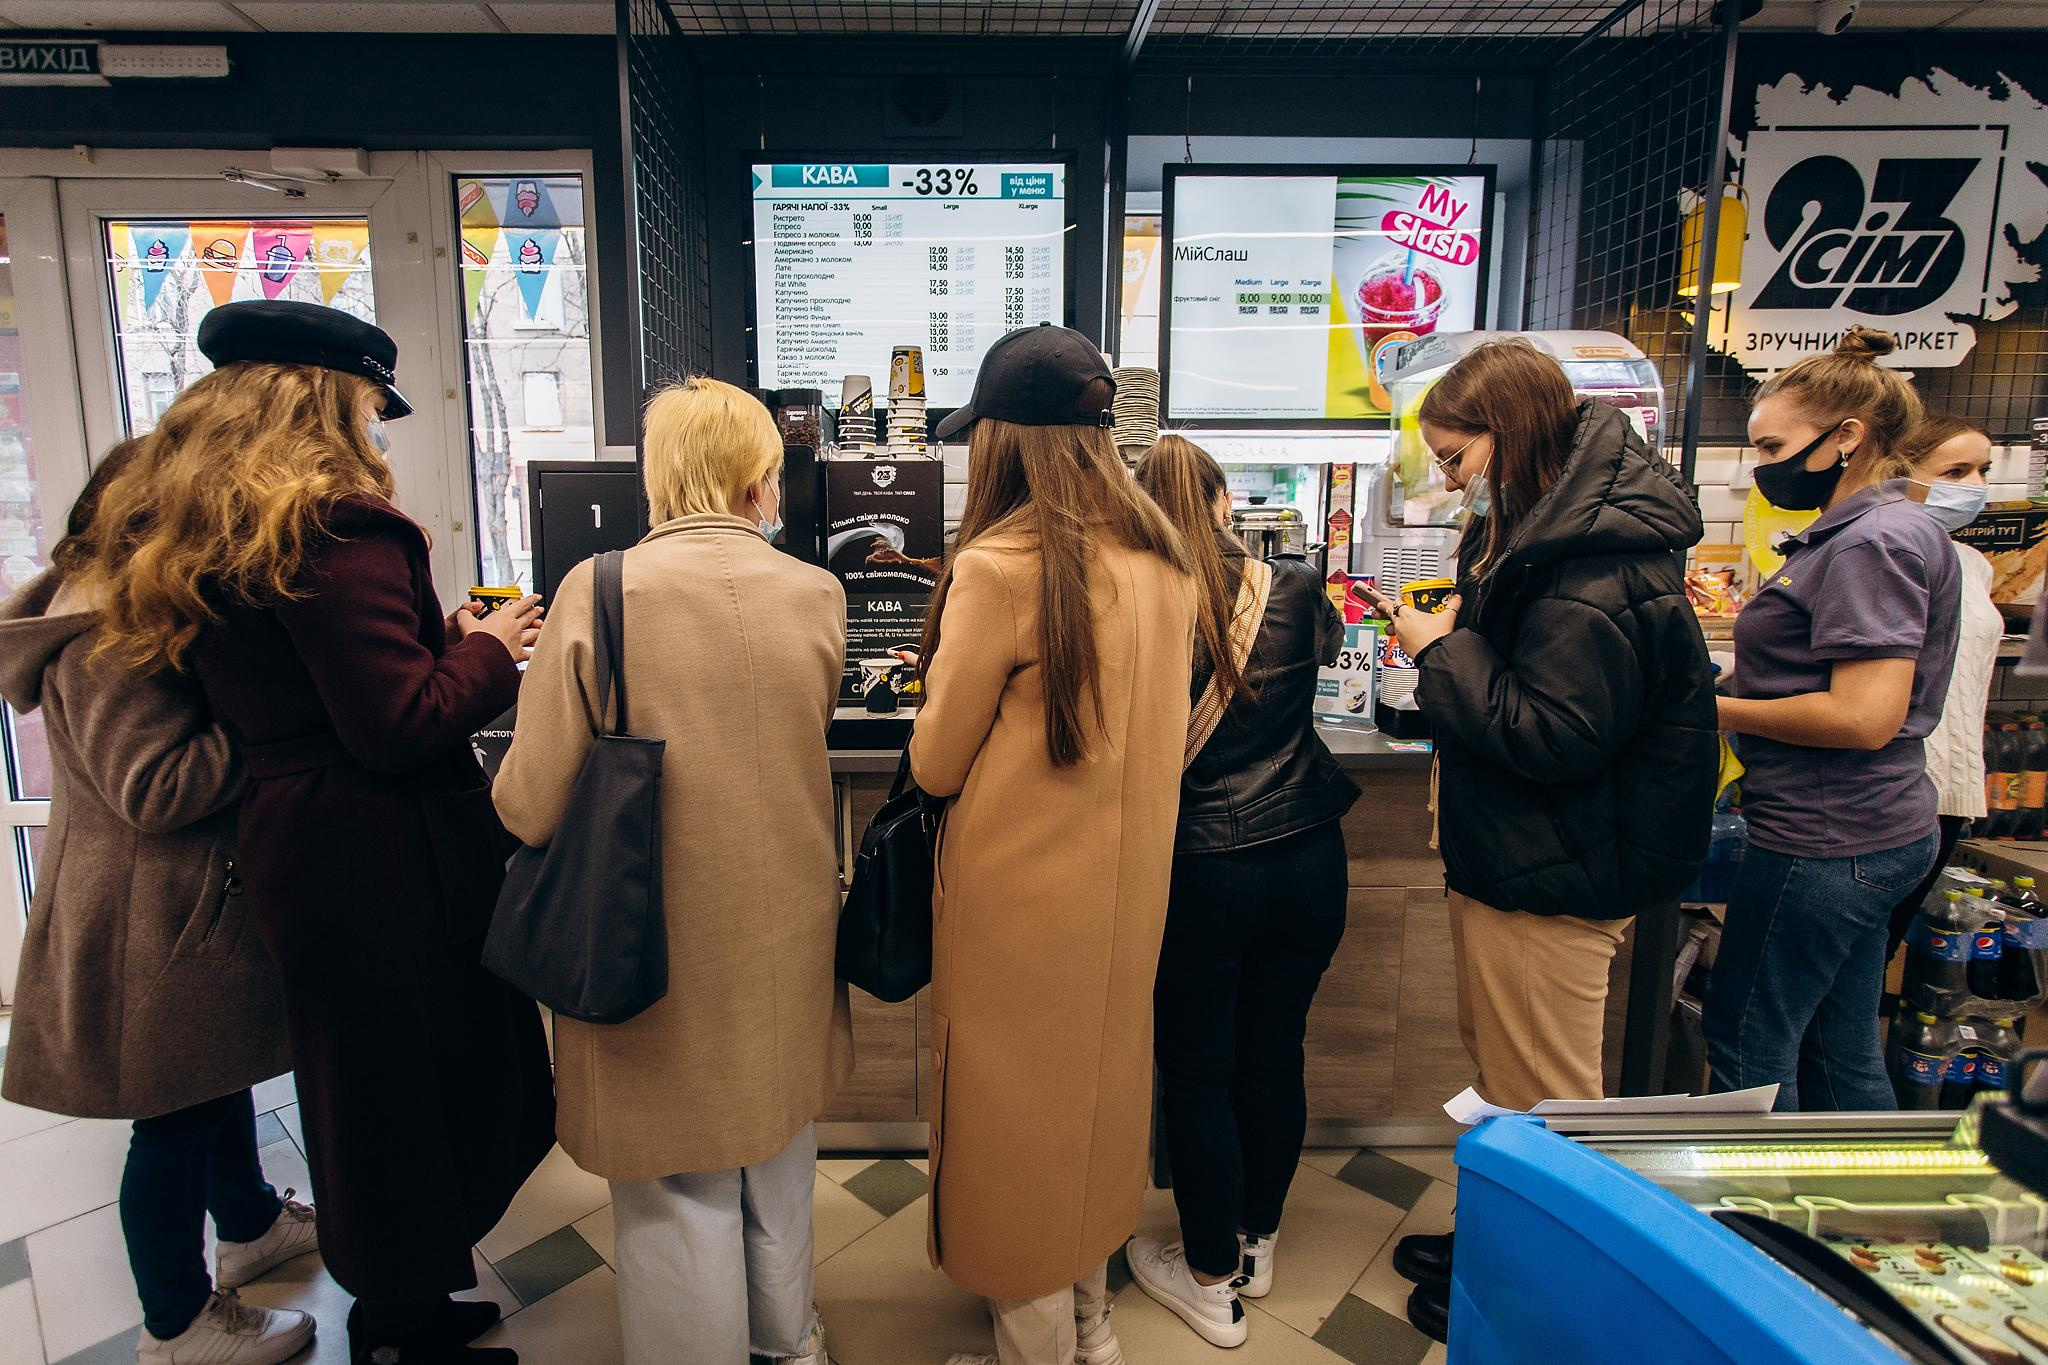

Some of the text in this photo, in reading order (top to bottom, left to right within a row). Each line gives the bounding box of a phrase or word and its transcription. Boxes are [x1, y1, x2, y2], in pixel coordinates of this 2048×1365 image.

[0, 48, 90, 71] ВИХІД
[802, 166, 978, 196] КАВА -33%
[1009, 176, 1046, 186] від ціни
[1011, 188, 1046, 197] у меню
[772, 202, 850, 211] ГАРЯЧІ НАПОЇ -33%
[1417, 184, 1468, 228] My
[773, 214, 805, 222] Ристрето
[853, 214, 872, 222] 10,00
[773, 223, 801, 231] Еспресо
[853, 222, 872, 230] 10,00
[773, 231, 802, 239] Еспресо
[855, 230, 872, 238] 11,50
[1393, 213, 1471, 263] Slush
[774, 248, 814, 256] Американо
[929, 246, 948, 255] 12,00
[1005, 246, 1024, 255] 14,50
[1174, 246, 1249, 262] МійСлаш
[774, 256, 814, 264] Американо
[929, 255, 948, 263] 13,00
[1005, 255, 1024, 263] 16,00
[929, 263, 948, 271] 14,50
[1005, 263, 1024, 271] 17,50
[774, 272, 792, 280] Лате
[1005, 271, 1024, 279] 17,50
[929, 279, 948, 288] 17,50
[1270, 279, 1289, 287] Large
[775, 289, 808, 297] Капучино
[929, 287, 948, 296] 14,50
[1005, 287, 1024, 296] 17,50
[775, 297, 808, 305] Капучино
[809, 297, 851, 305] прохолодне
[1005, 296, 1024, 304] 17,50
[1173, 295, 1208, 303] фруктовий
[1239, 294, 1260, 304] 8,00
[1271, 294, 1292, 304] 9,00
[1299, 294, 1323, 304] 10,00
[775, 305, 808, 313] Капучино
[1005, 303, 1024, 312] 14,00
[775, 313, 809, 321] Капучино
[929, 311, 948, 320] 13,00
[1005, 311, 1024, 320] 14,50
[776, 330, 809, 338] Капучино
[929, 328, 948, 336] 13,00
[776, 338, 809, 346] Капучино
[929, 336, 948, 344] 13,00
[1746, 331, 1847, 351] ЗРУЧНИ
[776, 345, 805, 354] Гарячий
[929, 344, 948, 352] 13,00
[932, 368, 949, 376] 9,50
[831, 513, 910, 530] тільки свіже молоко
[1956, 525, 2017, 537] ОЗІГРІЙ ТУТ
[844, 570, 936, 587] 100% свіжомелена кава
[867, 600, 903, 612] КАВА
[480, 730, 515, 738] ЧИСТОТУ
